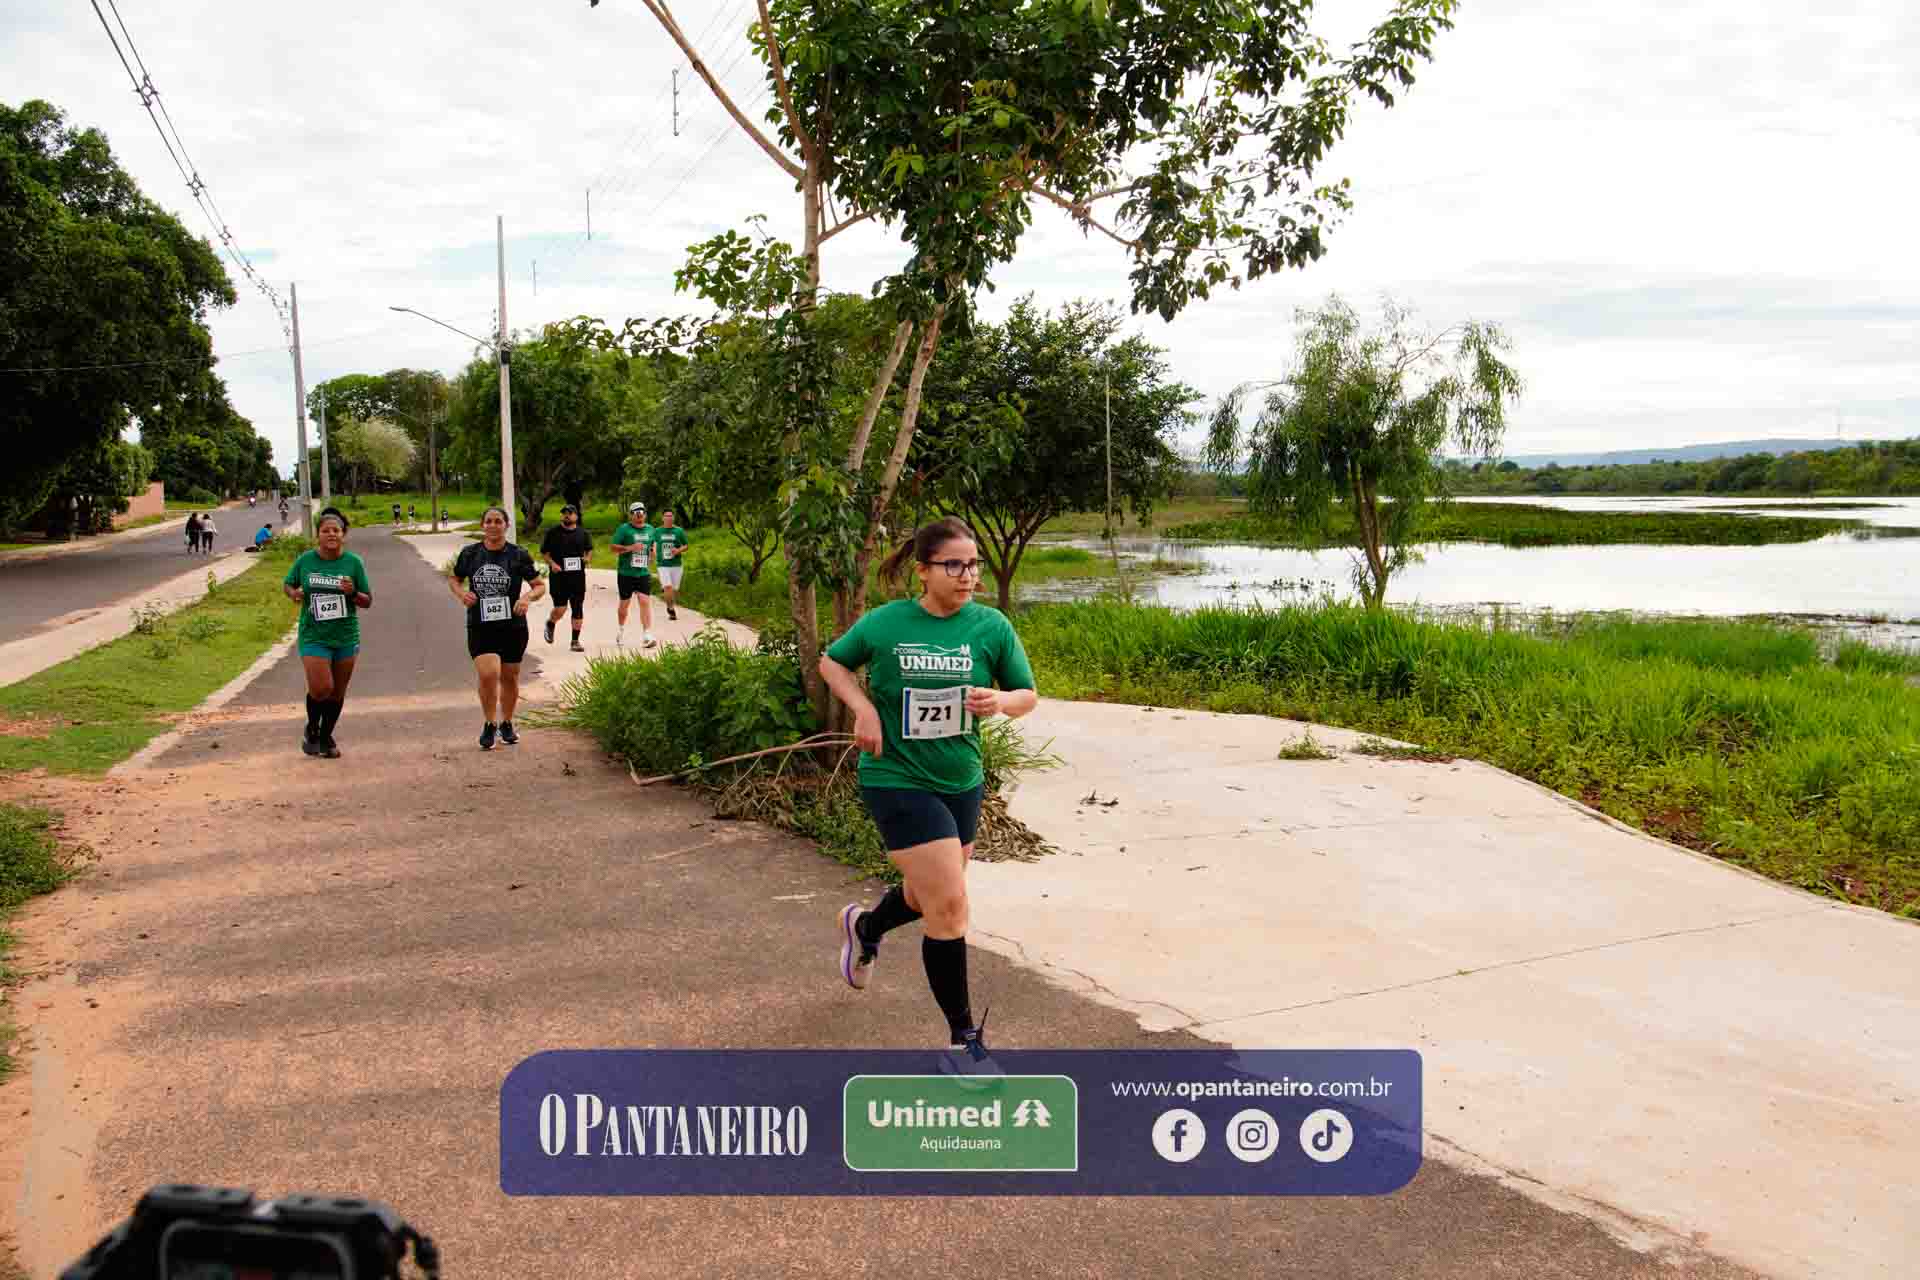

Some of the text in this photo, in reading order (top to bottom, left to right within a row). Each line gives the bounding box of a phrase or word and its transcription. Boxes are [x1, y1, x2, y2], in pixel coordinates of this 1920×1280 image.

[321, 602, 338, 612] 628
[487, 604, 502, 613] 682
[899, 655, 974, 671] UNIMED
[918, 705, 952, 721] 721
